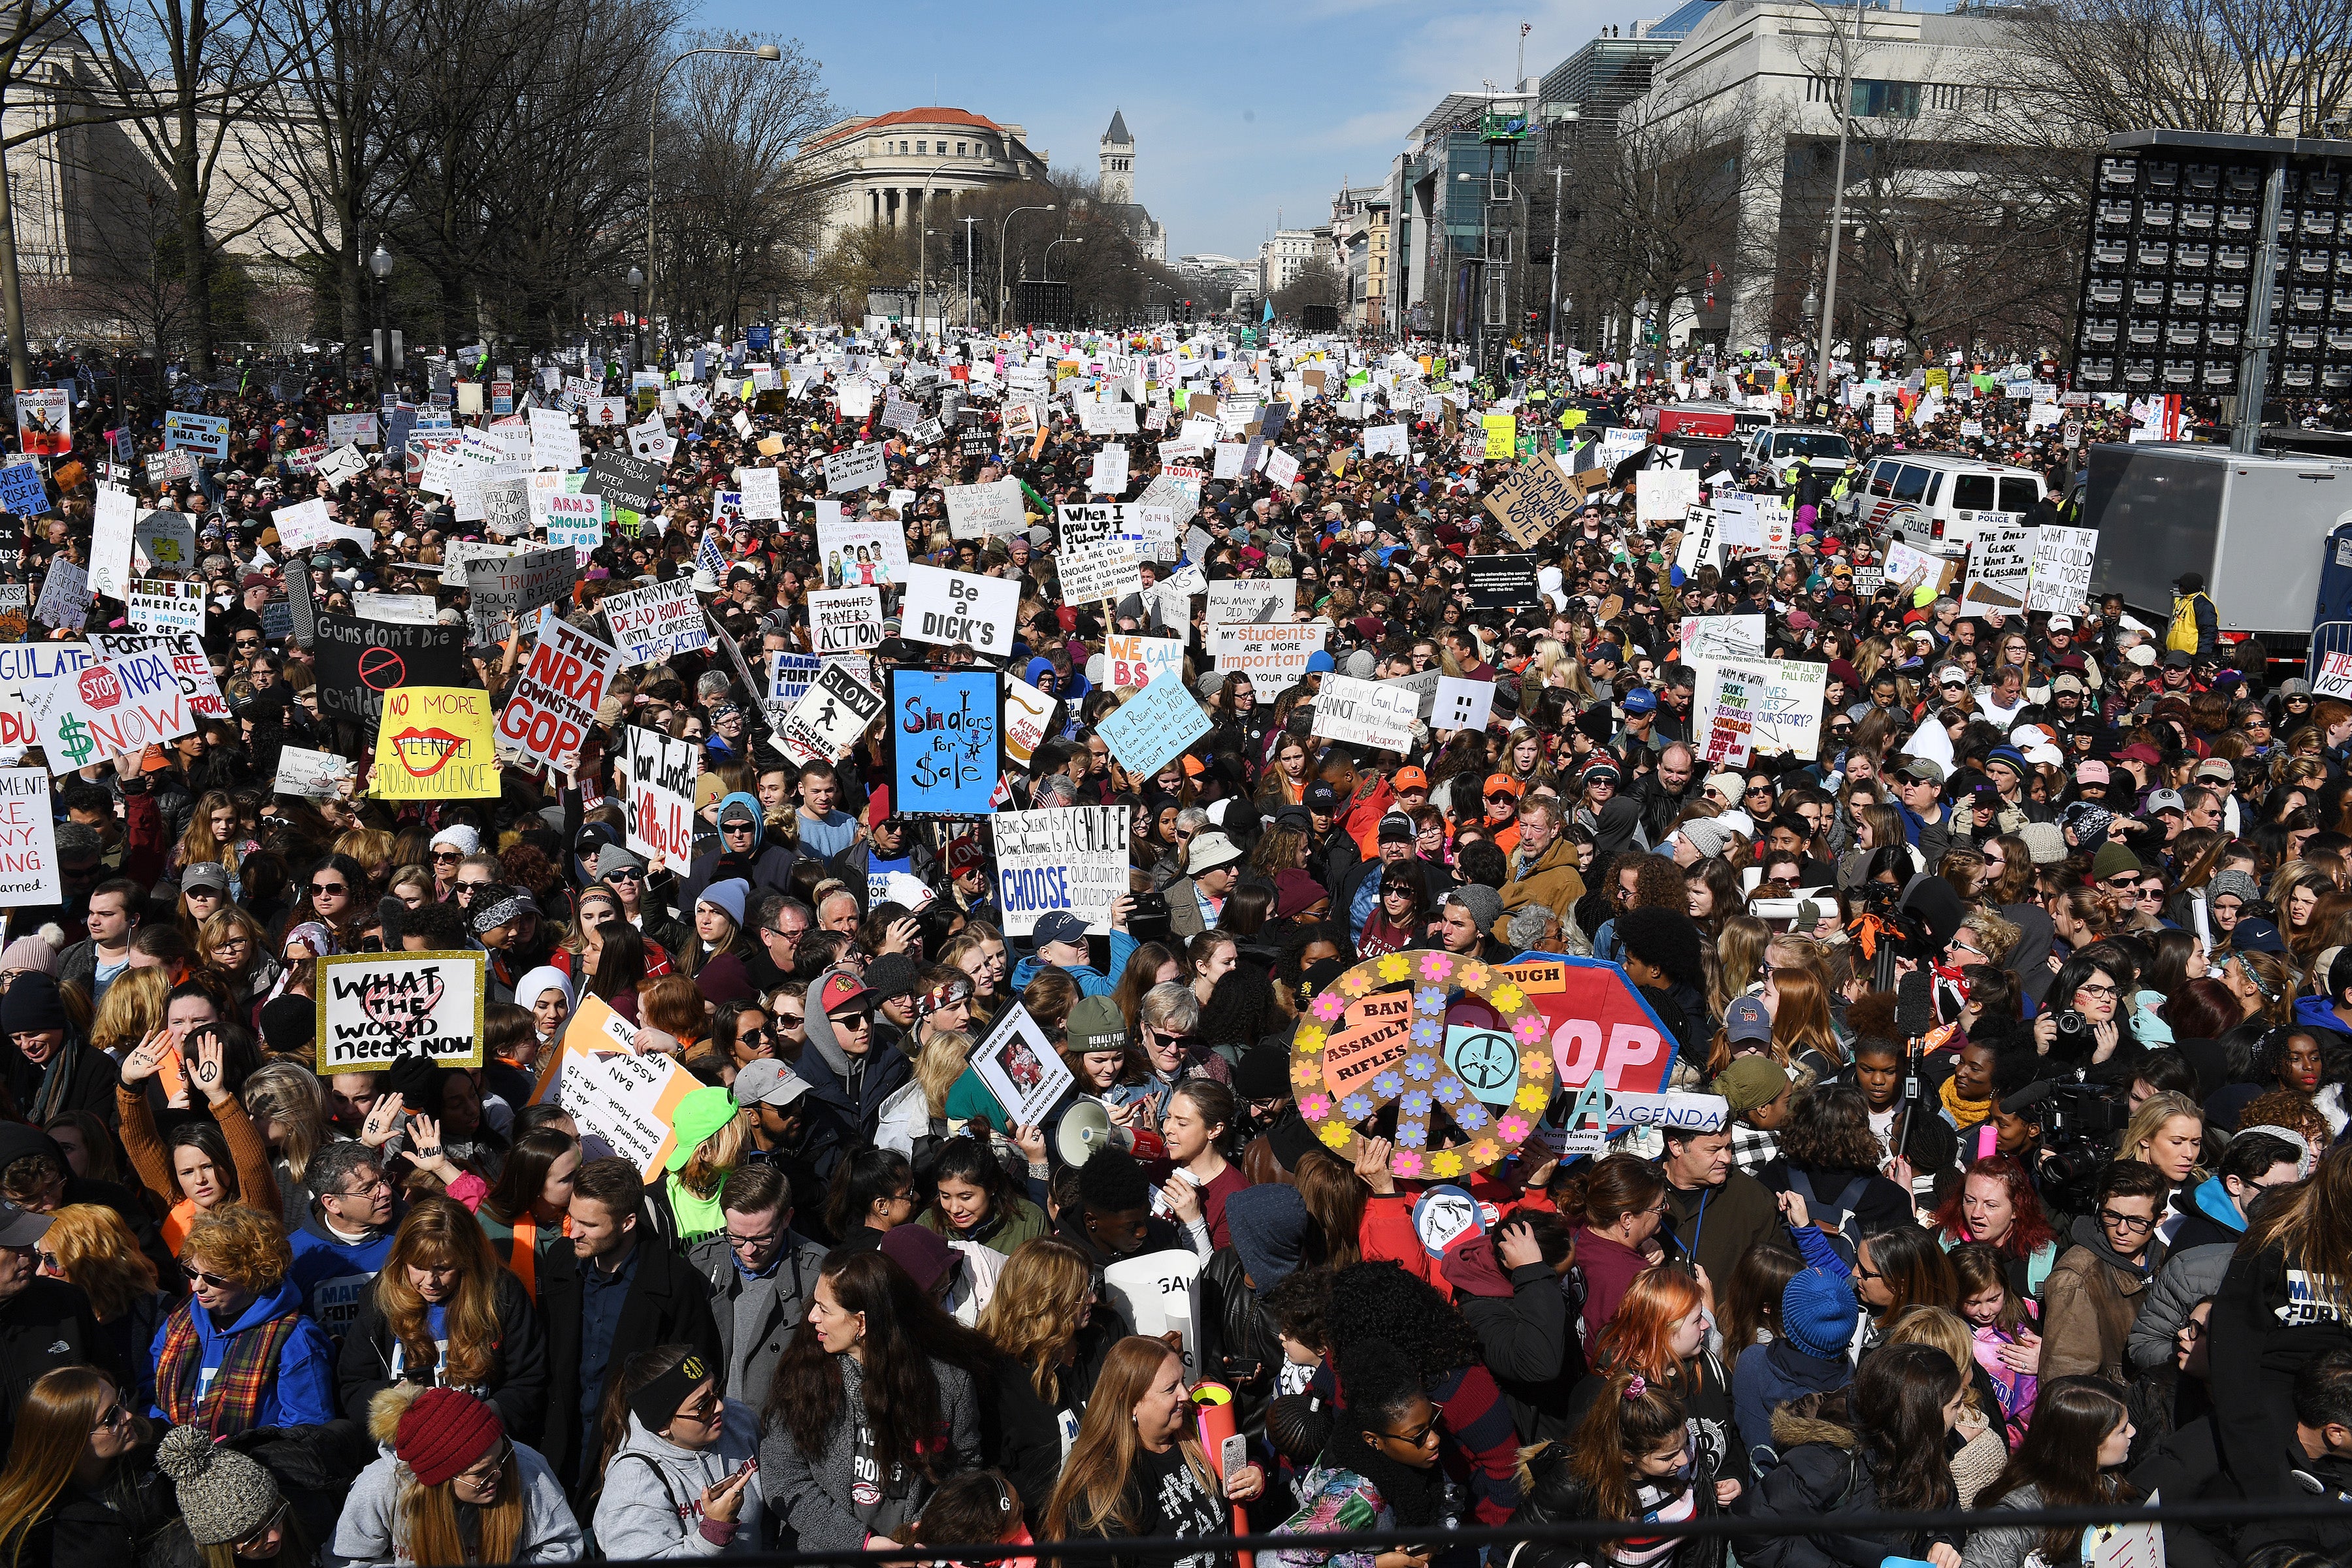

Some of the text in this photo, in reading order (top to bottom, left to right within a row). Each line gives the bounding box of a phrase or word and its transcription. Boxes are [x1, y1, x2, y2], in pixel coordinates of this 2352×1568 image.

[1109, 356, 1136, 376] NRA
[567, 385, 595, 398] KILLING
[572, 378, 596, 391] STOP
[2008, 387, 2030, 396] STUPID
[19, 397, 66, 407] Replaceable!
[573, 394, 587, 402] US
[913, 421, 936, 433] PROTECT
[920, 428, 934, 438] KIDS
[1465, 428, 1488, 439] ENOUGH
[154, 451, 174, 460] WANT
[601, 451, 647, 472] STUDENT
[1462, 445, 1486, 457] ENOUGH
[148, 456, 189, 471] READ BOOKS
[1164, 466, 1201, 478] TODAY
[596, 470, 624, 488] VOTER
[623, 468, 651, 483] TODAY.
[1526, 456, 1578, 511] I STAND
[553, 497, 595, 513] ARMS
[601, 485, 650, 509] TOMORROW
[1509, 472, 1560, 528] STUDENTS
[547, 515, 598, 529] SHOULD
[1492, 485, 1540, 540] I VOTE
[1903, 519, 1929, 534] POLICE
[1979, 532, 1997, 542] THE
[2041, 527, 2092, 547] WHAT THE
[549, 532, 597, 544] BE FOR
[1988, 543, 2016, 553] GLOCK
[1972, 557, 1978, 566] I
[2037, 546, 2093, 566] HELL COULD
[1983, 567, 2028, 578] CLASSROOM
[2035, 564, 2089, 585] BE MORE
[604, 578, 694, 615] HOW MANY MORE
[949, 580, 979, 601] Be
[2032, 580, 2085, 600] VALUABLE THAN
[815, 596, 873, 610] THOUGHTS
[955, 602, 967, 615] a
[131, 610, 196, 626] ITS HARDER
[612, 598, 700, 633] DEAD BODIES
[821, 610, 869, 626] PRAYERS
[317, 617, 450, 648] Guns don't Die
[623, 615, 704, 645] UNTIL CONGRESS
[821, 623, 881, 649] ACTION
[923, 612, 994, 645] DICK'S
[1238, 625, 1316, 641] students
[556, 626, 610, 670] THE
[676, 628, 709, 652] ACTION
[1108, 637, 1182, 671] WE CALL
[81, 654, 178, 701] STOP NRA
[527, 642, 604, 711] NRA
[1782, 672, 1820, 682] FALL FOR?
[824, 670, 875, 713] SLOW
[389, 693, 479, 717] NO MORE
[518, 678, 593, 729] OWNS THE
[500, 696, 581, 762] GOP
[1017, 718, 1043, 739] ACTION
[1777, 713, 1812, 727] STORY?
[792, 715, 836, 754] CHILDREN
[1009, 727, 1036, 751] CHANGE
[630, 727, 695, 803] Your Inaction
[628, 785, 689, 861] is Us
[1073, 806, 1126, 852] CHOICE
[1002, 866, 1125, 911] CHOOSE OUR COUNTRY
[333, 966, 440, 1000] WHAT
[370, 997, 429, 1015] THE
[1364, 1000, 1408, 1017] BAN
[335, 1019, 437, 1040] WORLD
[1004, 1008, 1022, 1032] POLICE
[421, 1036, 474, 1057] NOW
[1088, 1032, 1124, 1045] DENALI PARK
[1327, 1018, 1409, 1062] ASSAULT
[1337, 1045, 1407, 1081] RIFLES
[609, 1067, 634, 1091] BAN
[1021, 1069, 1058, 1114] #STEPHONCLARK
[567, 1066, 660, 1144] Sandy Hook AR-15
[1607, 1105, 1718, 1126] AGENDA
[560, 1080, 653, 1160] Parkland AR-15
[368, 1118, 442, 1159] # ENOUGH
[1441, 1218, 1467, 1241] STOP IT!
